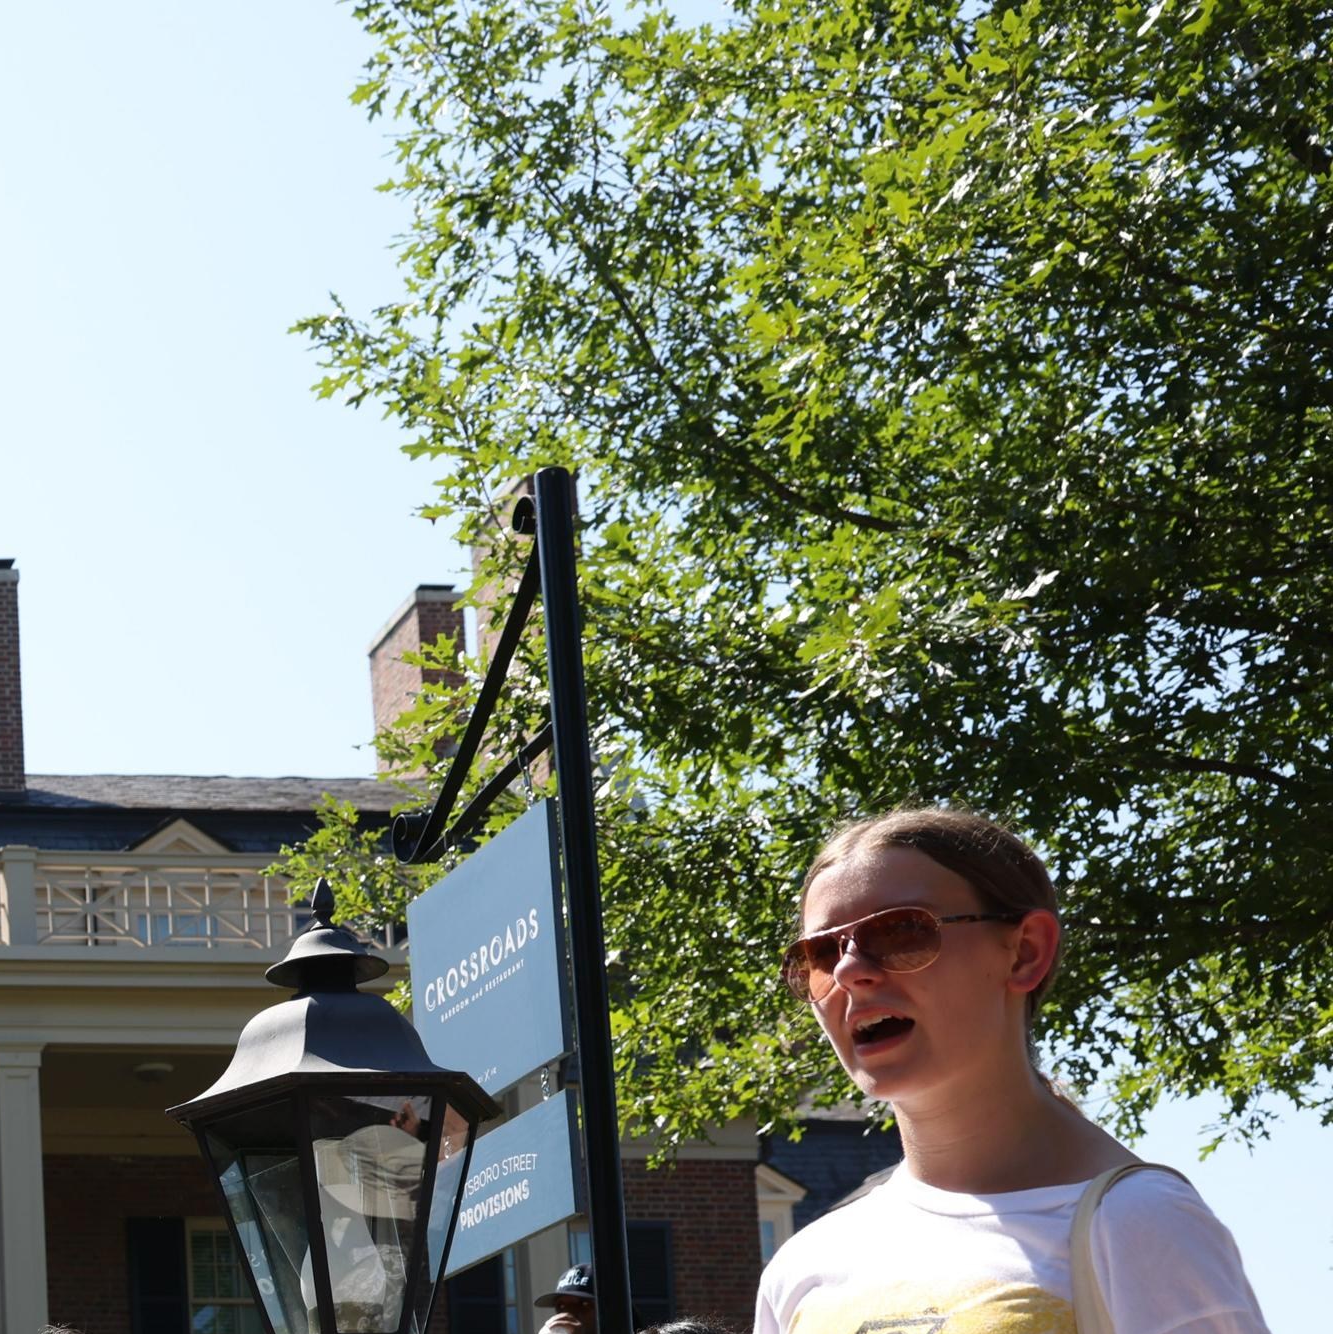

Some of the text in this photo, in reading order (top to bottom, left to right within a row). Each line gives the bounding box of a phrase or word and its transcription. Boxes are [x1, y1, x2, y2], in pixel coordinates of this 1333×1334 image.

[425, 908, 539, 1012] CROSSROADS
[440, 958, 525, 1023] BARROOM and RESTAURANT
[502, 1153, 538, 1176] STREET
[459, 1179, 530, 1231] PROVISIONS
